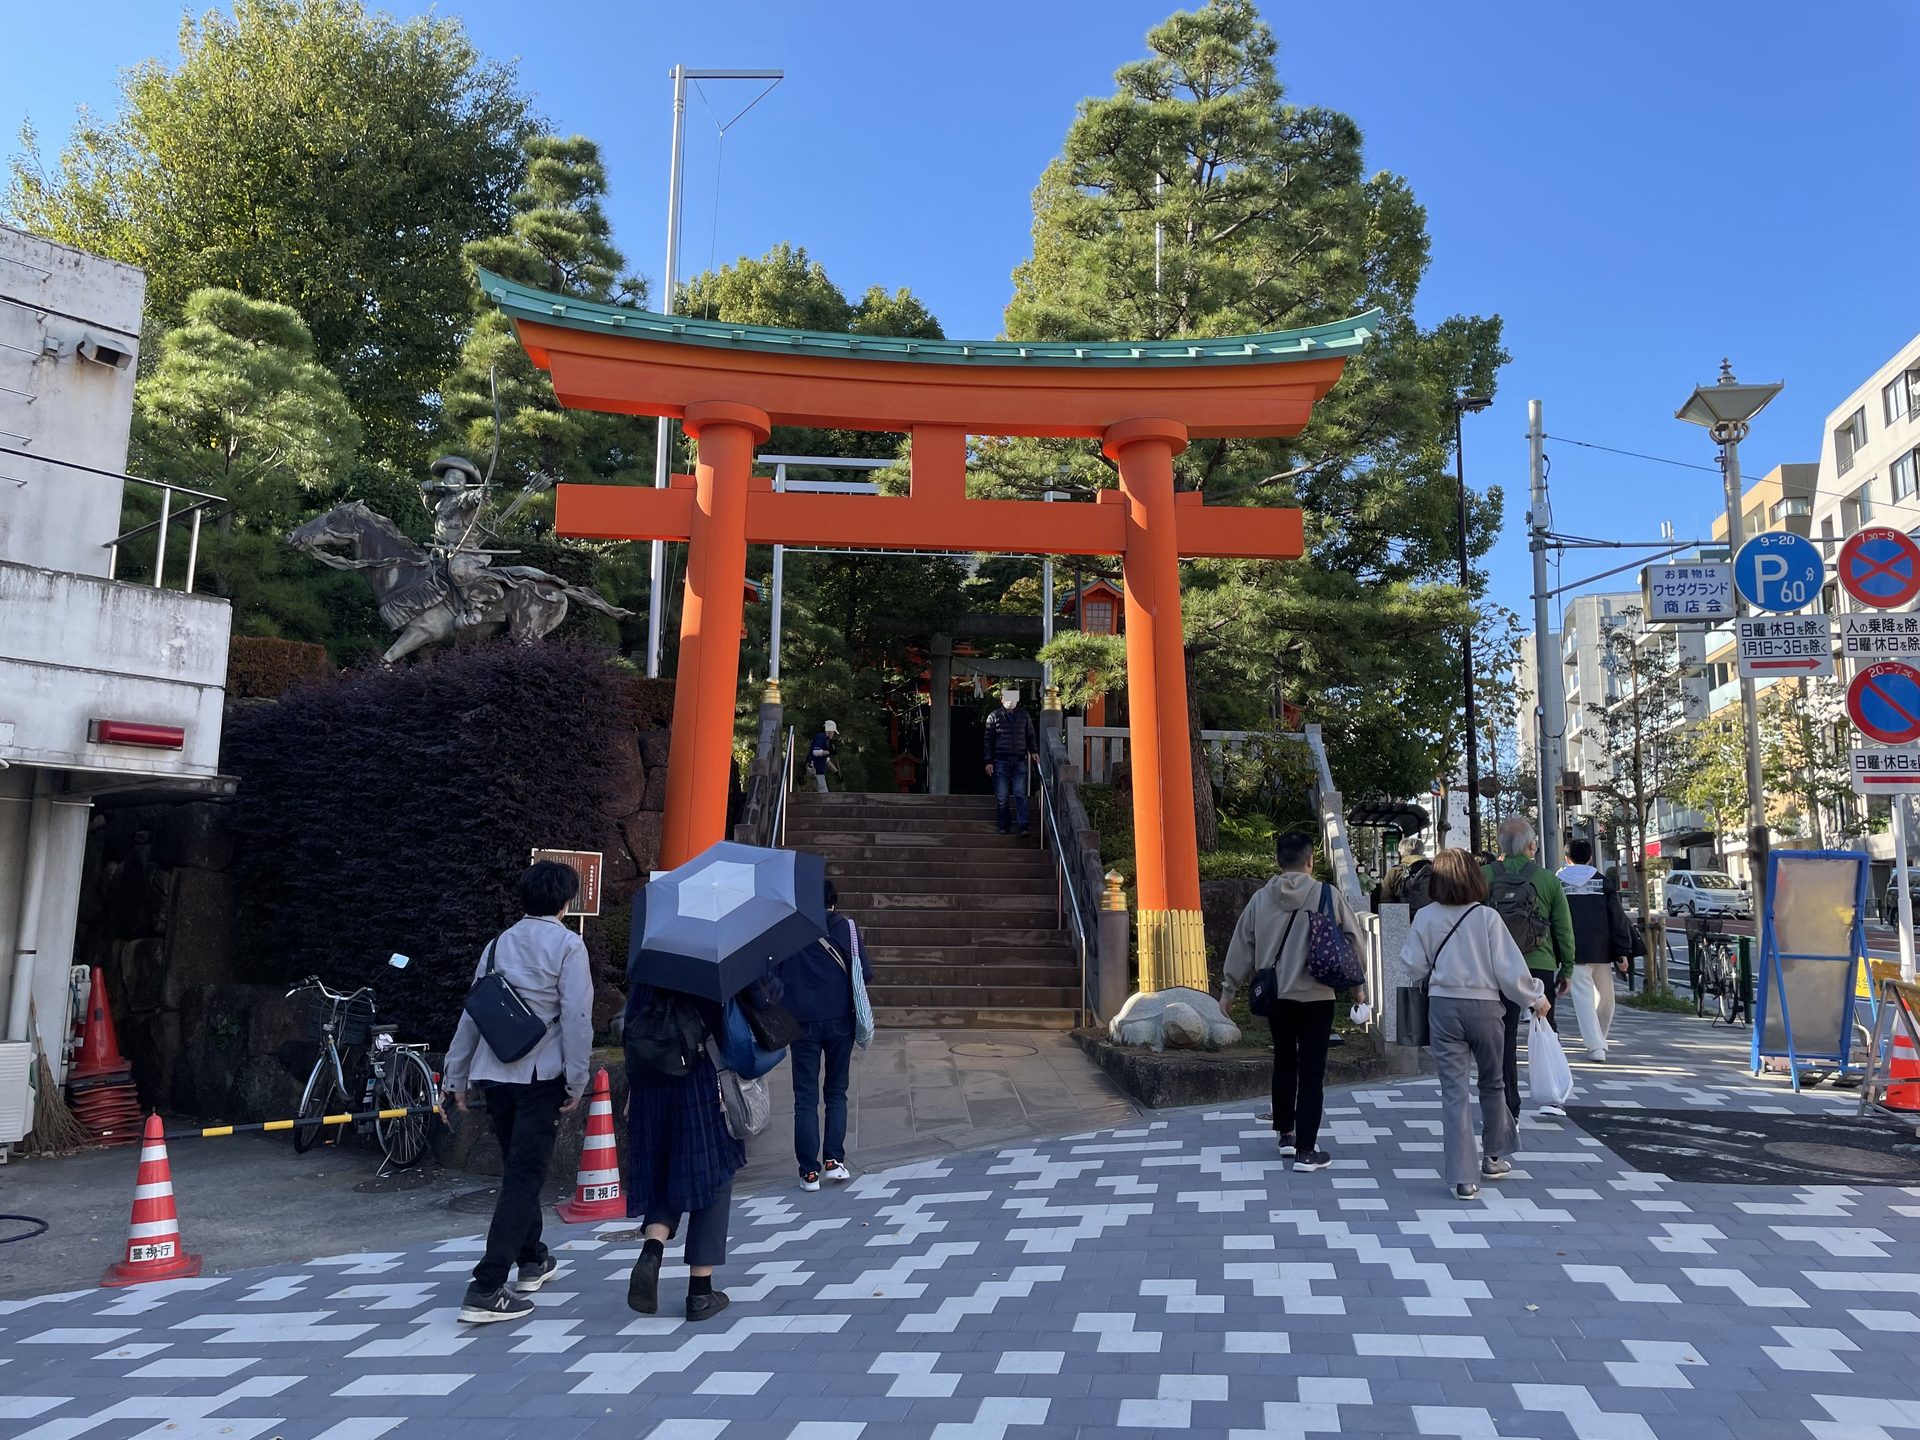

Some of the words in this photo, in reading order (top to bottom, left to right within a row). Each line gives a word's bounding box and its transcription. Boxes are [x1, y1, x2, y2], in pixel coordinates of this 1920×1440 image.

[1760, 535, 1795, 546] 9-20
[1664, 569, 1716, 579] お買物は
[1754, 554, 1788, 604] P
[1653, 582, 1729, 597] ワセダグランド
[1780, 581, 1805, 603] 60
[1805, 567, 1815, 581] 分
[1664, 599, 1721, 613] 商店会
[1846, 618, 1918, 634] 人の乗降を除
[1855, 755, 1920, 769] 日曜・休日を
[585, 1186, 618, 1200] 警視庁
[133, 1244, 171, 1260] 警視庁
[495, 1296, 510, 1310] N
